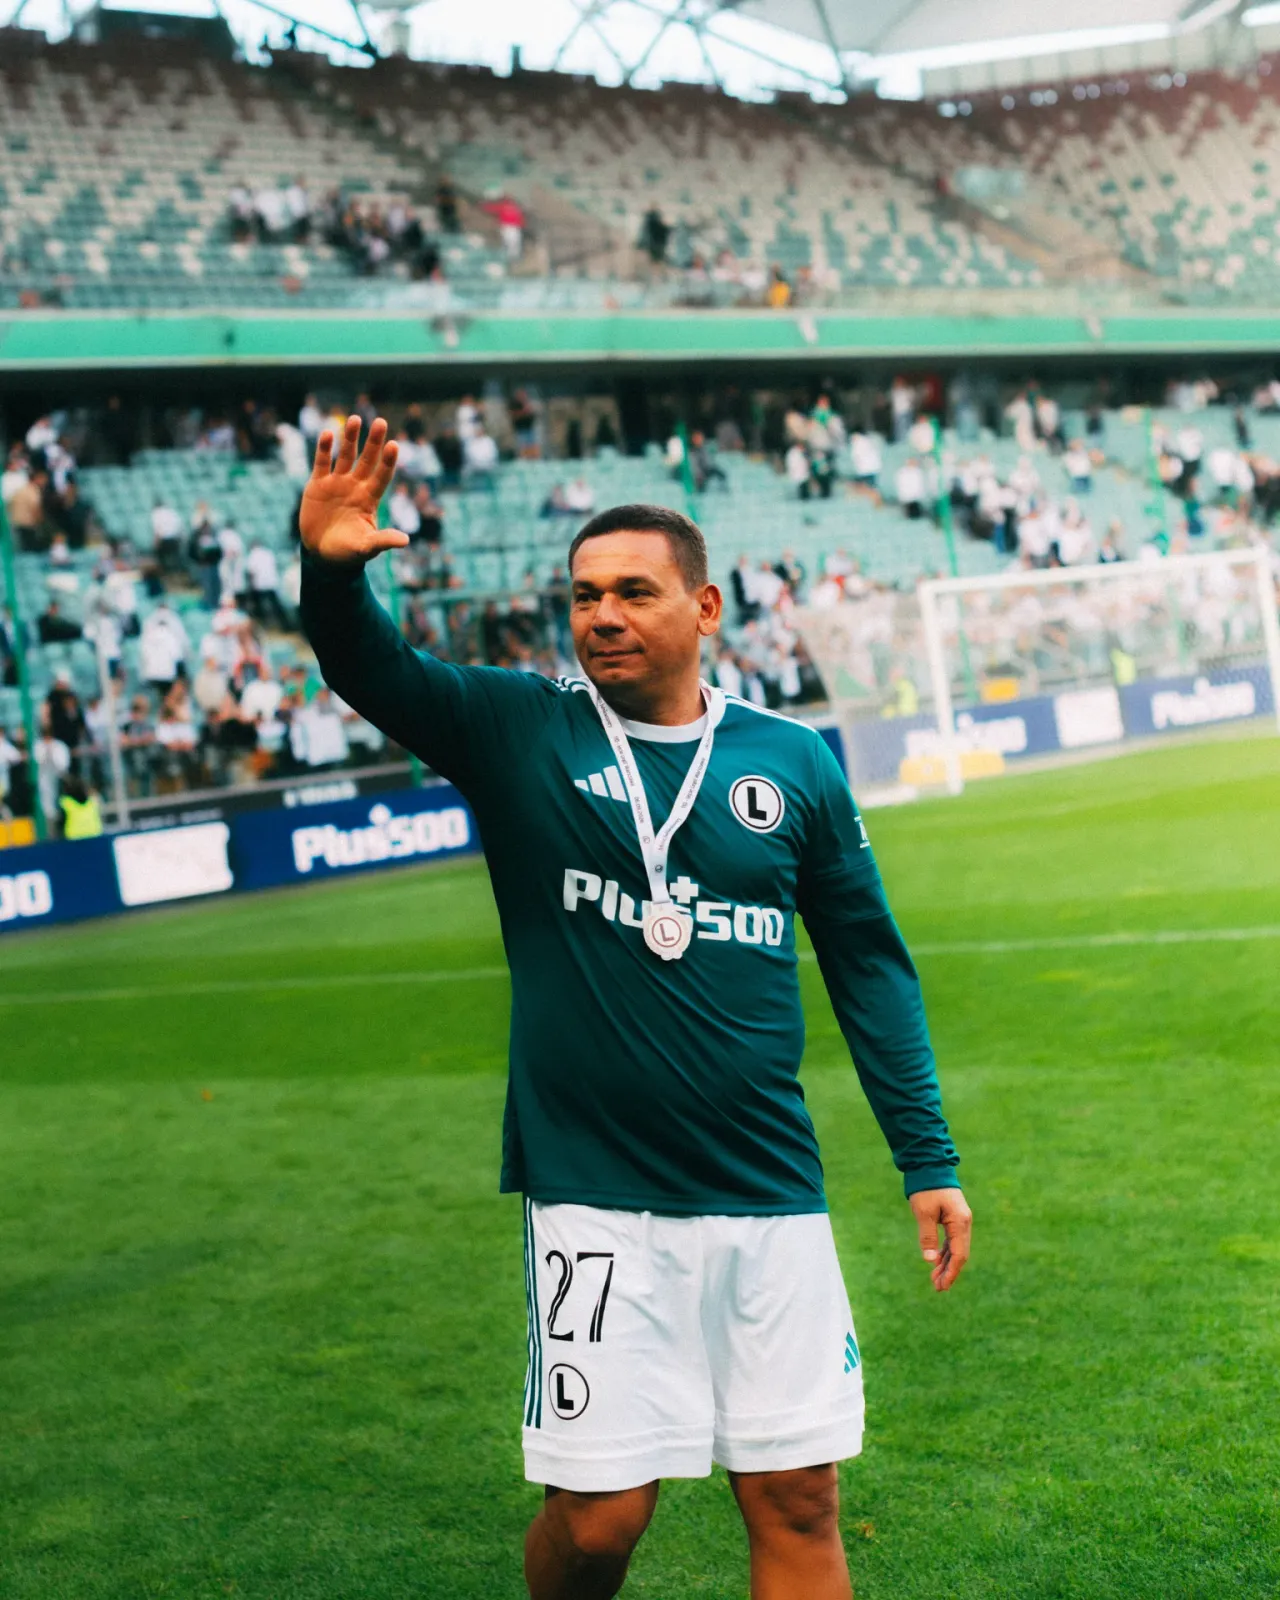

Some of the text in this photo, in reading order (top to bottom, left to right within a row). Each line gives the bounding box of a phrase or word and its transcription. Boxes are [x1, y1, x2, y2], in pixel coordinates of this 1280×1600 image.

[747, 786, 768, 821] L
[659, 923, 675, 942] L
[545, 1250, 614, 1342] 27
[556, 1373, 574, 1410] L
